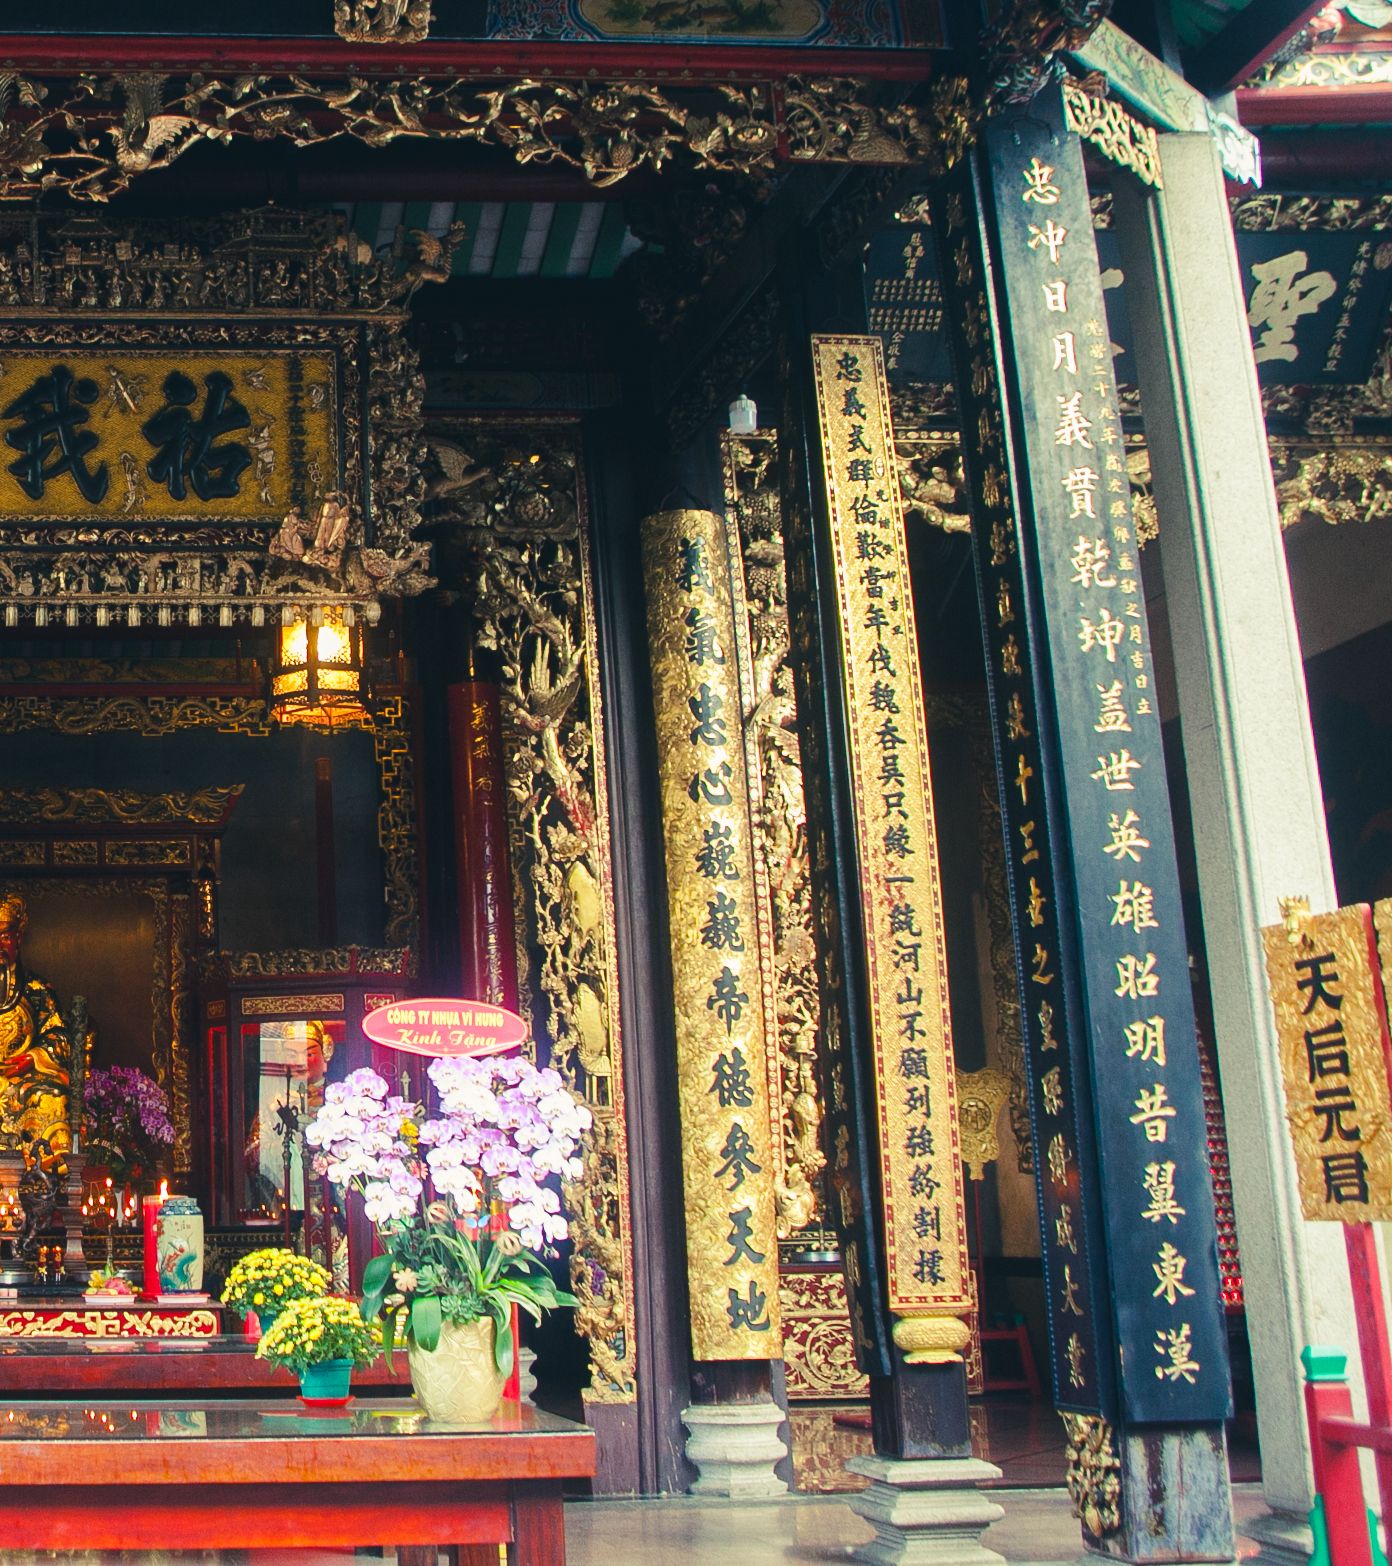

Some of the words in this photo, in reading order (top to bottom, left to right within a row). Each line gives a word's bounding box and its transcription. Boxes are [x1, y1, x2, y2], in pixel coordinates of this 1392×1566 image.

[387, 1007, 415, 1024] CÔNG
[418, 1010, 429, 1024] TY
[1295, 951, 1370, 1205] 天后元君
